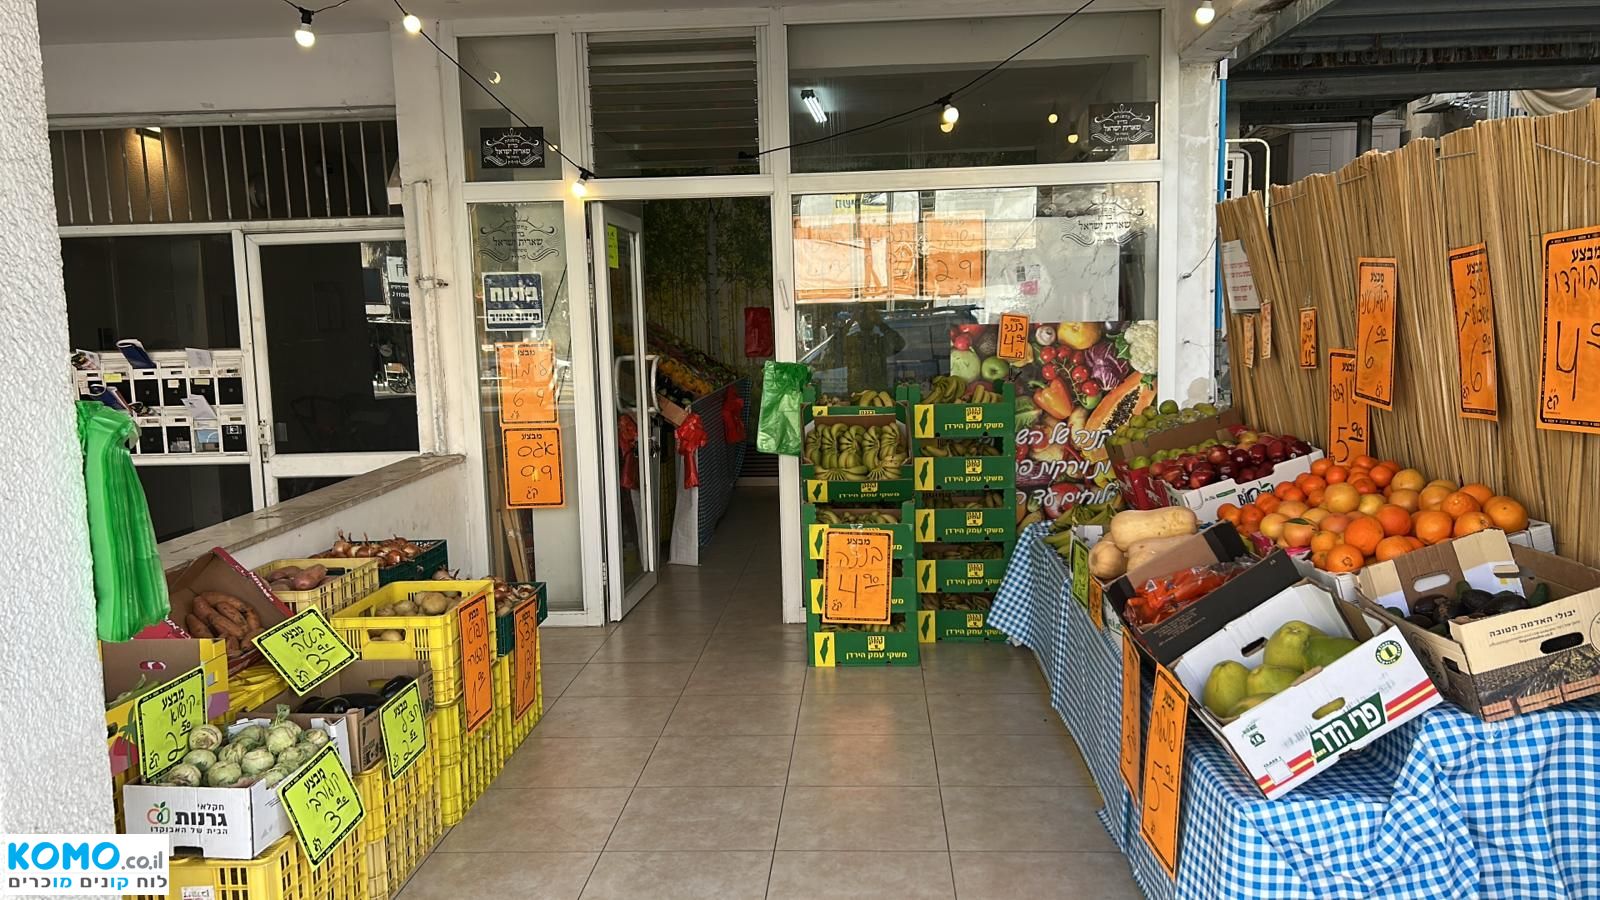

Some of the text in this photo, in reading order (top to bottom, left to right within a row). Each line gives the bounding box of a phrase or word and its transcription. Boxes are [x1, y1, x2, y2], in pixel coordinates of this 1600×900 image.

[1078, 220, 1131, 230] שארית ישראל
[493, 236, 543, 246] שארית ישראל
[1555, 265, 1600, 298] בוקדו
[489, 285, 539, 303] פתוח
[945, 423, 964, 431] הירדן
[966, 423, 982, 431] עמק
[1049, 422, 1070, 445] של
[517, 442, 555, 458] אגס
[966, 527, 982, 535] עמק
[846, 537, 870, 546] מבצע
[835, 546, 883, 570] בננה
[947, 578, 966, 586] הירדן
[968, 578, 983, 586] עמק
[838, 573, 858, 608] 4
[1521, 615, 1553, 630] האדמה
[1554, 609, 1576, 621] יבולי
[281, 626, 304, 642] מבצע
[967, 628, 983, 636] עמק
[1489, 623, 1518, 638] הטובה
[291, 627, 325, 652] בטטה
[306, 653, 330, 674] 3
[846, 651, 907, 660] משקי עמק הירדן
[162, 687, 185, 711] מבצע
[170, 694, 195, 726] קישוא
[393, 700, 408, 719] מבצע
[1313, 701, 1382, 753] פרי הדר
[166, 732, 186, 762] 2
[402, 740, 414, 760] 2
[303, 767, 327, 794] מבצע
[197, 803, 224, 811] חקלאי
[175, 811, 227, 826] גרנות
[324, 810, 342, 833] 3
[150, 826, 187, 834] האבוקדו
